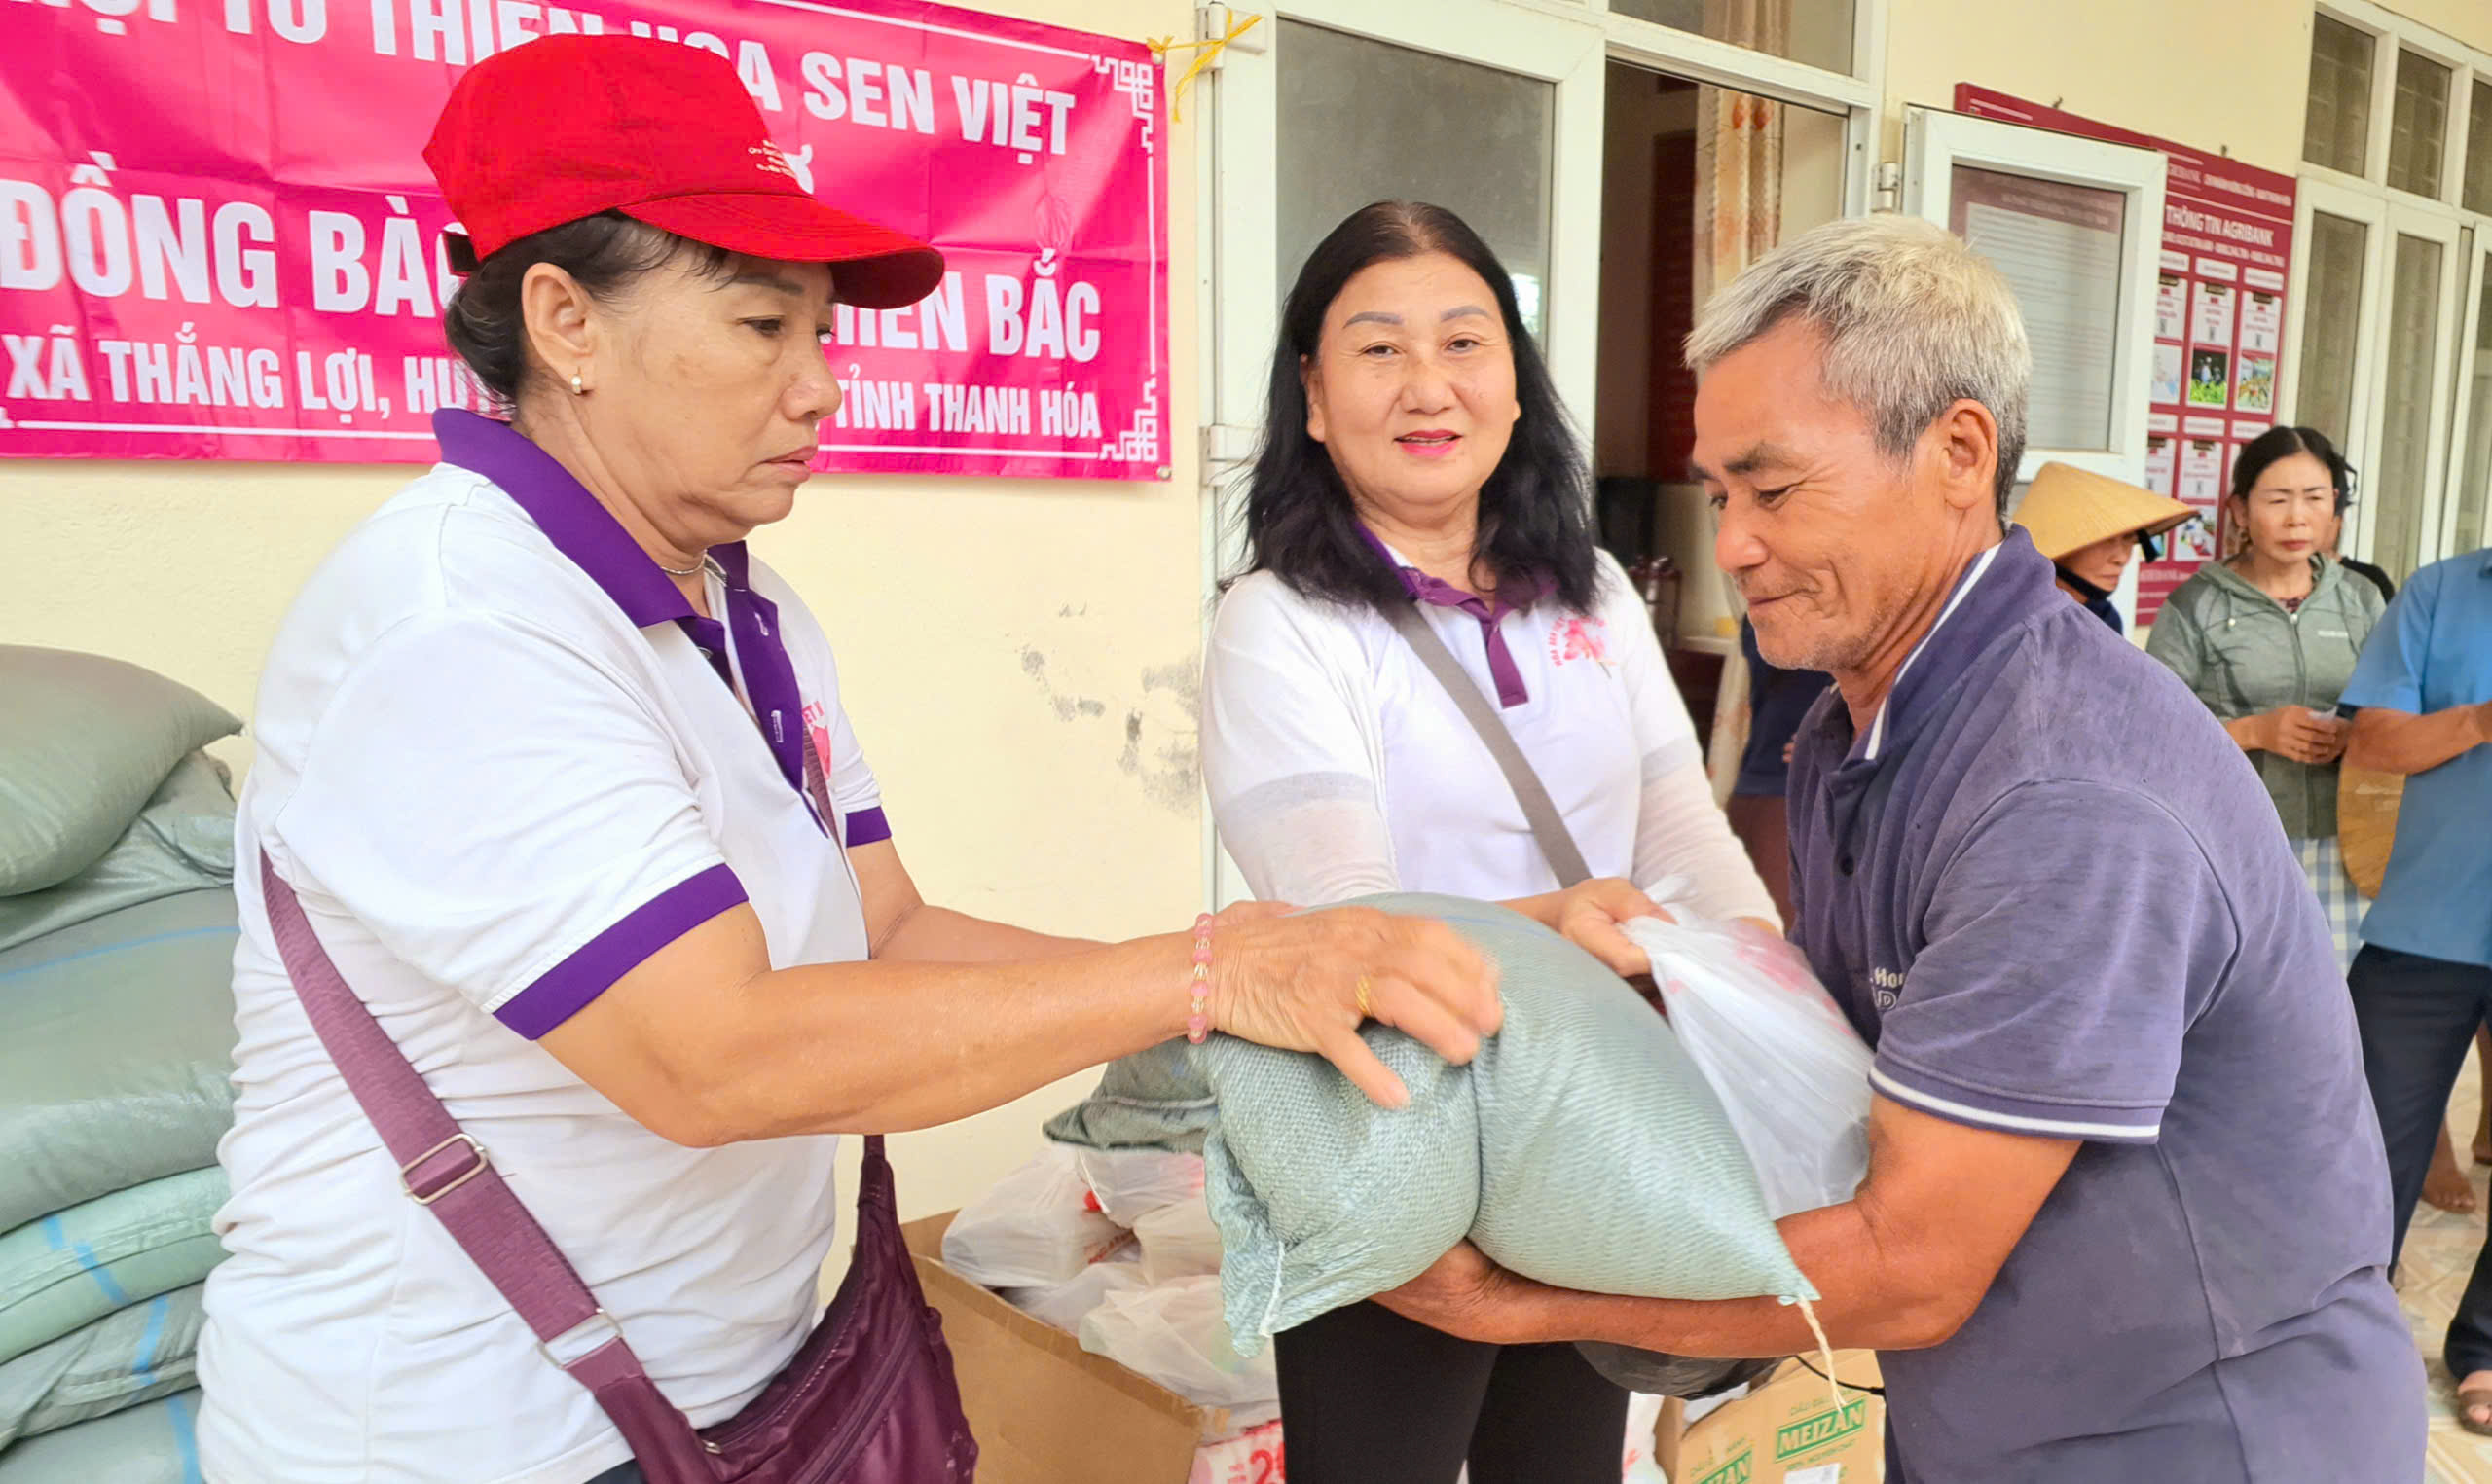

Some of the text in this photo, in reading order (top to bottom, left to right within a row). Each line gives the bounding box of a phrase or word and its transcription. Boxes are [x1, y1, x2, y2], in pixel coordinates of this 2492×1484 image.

[801, 52, 934, 135] SEN
[952, 72, 1076, 164] VIỆT
[0, 151, 279, 309] ĐỒNG
[987, 249, 1101, 363] BẮC
[3, 325, 92, 401] XÃ
[99, 322, 284, 409] THẮNG
[296, 346, 391, 422] LỢI,
[834, 363, 1102, 438] TỈNH THANH HÓA
[1779, 1402, 1865, 1455] MEIZAN
